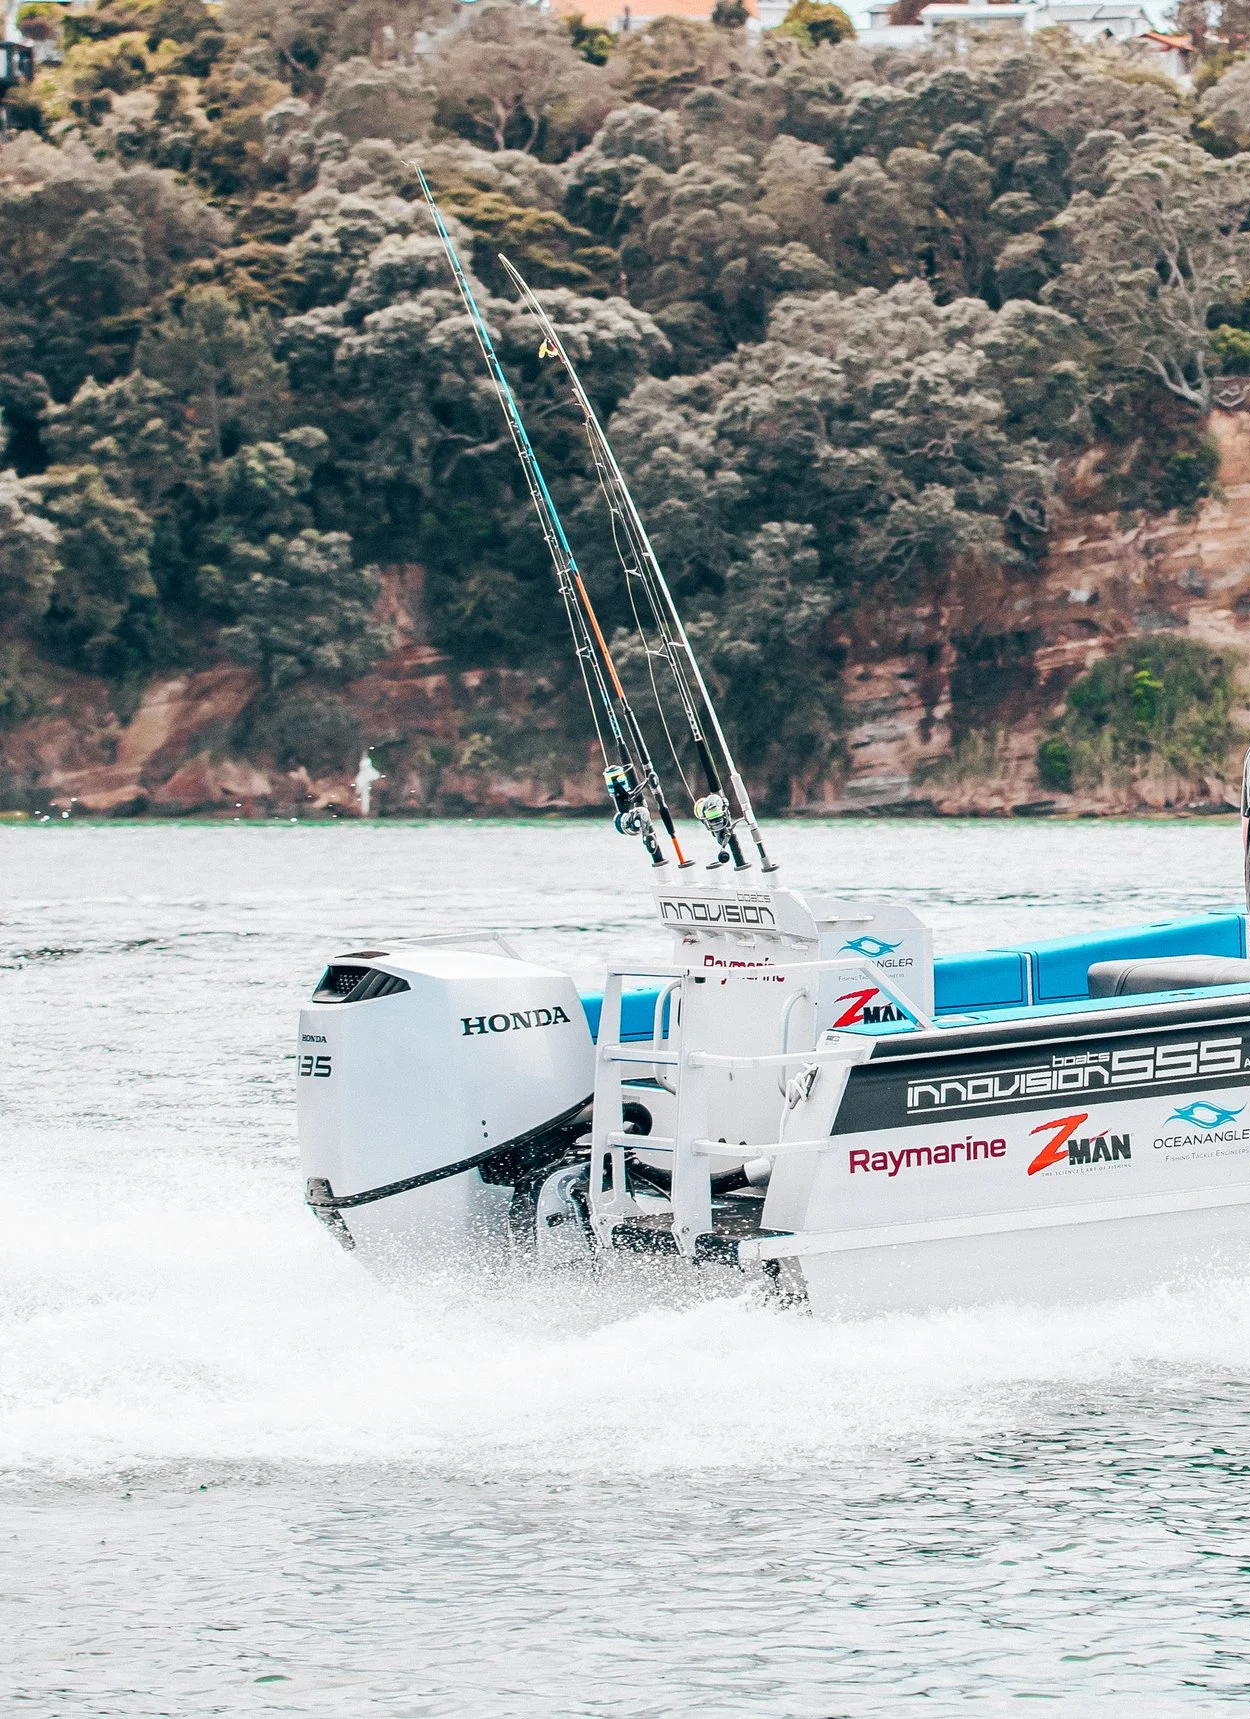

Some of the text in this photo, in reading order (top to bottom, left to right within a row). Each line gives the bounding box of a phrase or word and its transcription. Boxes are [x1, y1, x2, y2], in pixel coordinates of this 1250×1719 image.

[460, 1005, 571, 1036] HONDA
[302, 1033, 328, 1043] HONDA
[1052, 1051, 1111, 1068] boats
[1111, 1036, 1243, 1084] 555
[849, 1135, 1007, 1178] Raymarine
